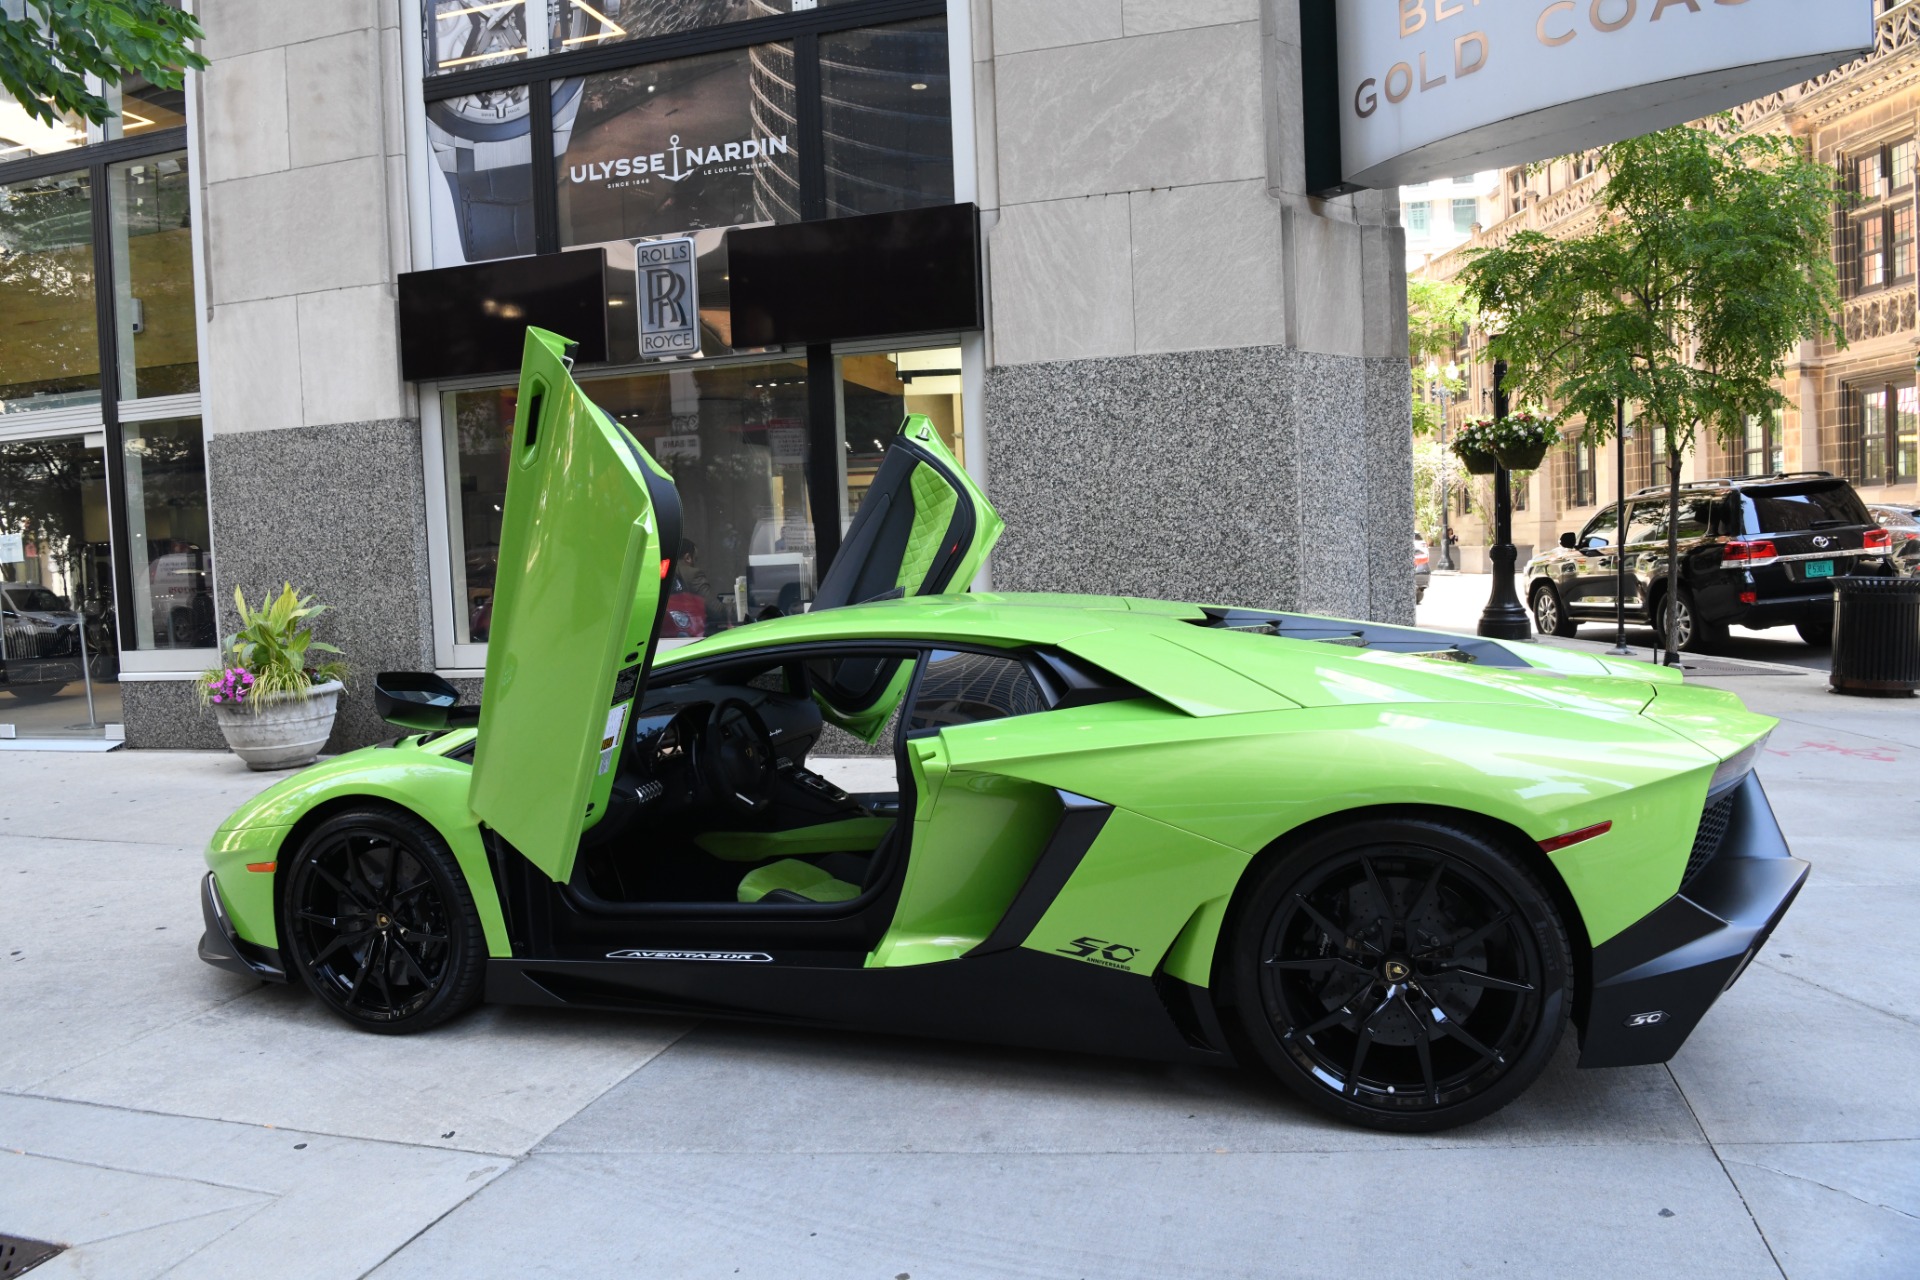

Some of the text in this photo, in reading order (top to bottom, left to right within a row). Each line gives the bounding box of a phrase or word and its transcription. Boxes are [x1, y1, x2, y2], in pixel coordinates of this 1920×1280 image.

[1354, 31, 1489, 119] GOLD
[570, 135, 788, 183] ULYSSE NARDIN
[714, 165, 737, 174] LOCLE
[607, 180, 630, 189] SINCE
[641, 246, 687, 263] ROLLS
[645, 333, 691, 349] ROYCE
[627, 951, 754, 960] AVENTADOR
[1086, 957, 1131, 971] ANNIVERSARIO
[1630, 1013, 1662, 1026] 50
